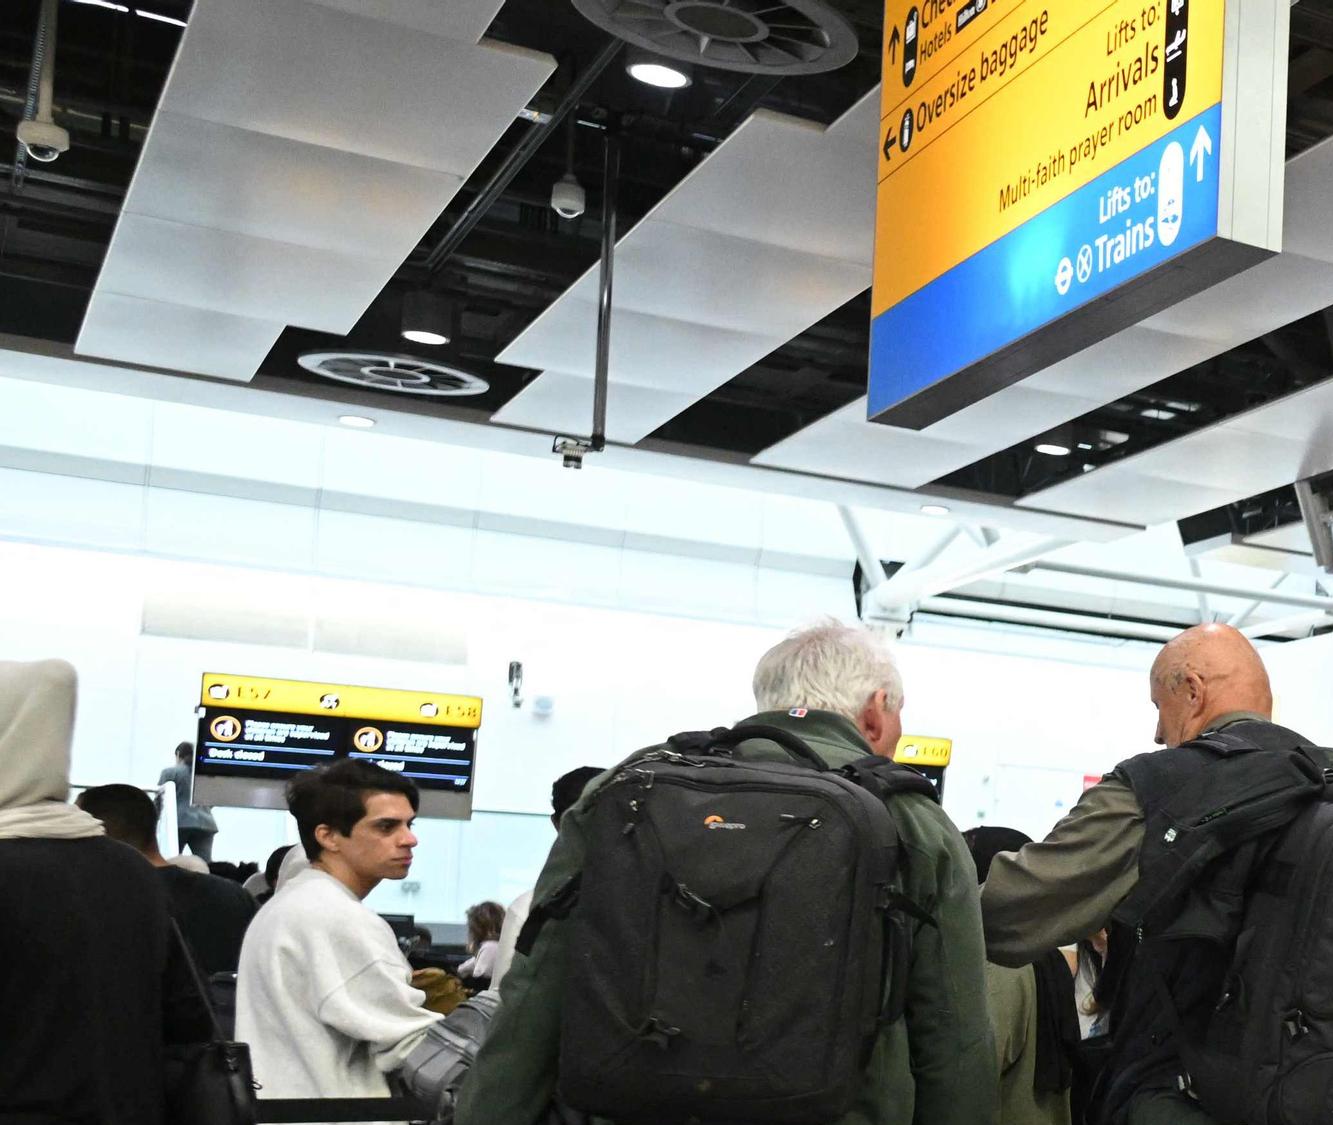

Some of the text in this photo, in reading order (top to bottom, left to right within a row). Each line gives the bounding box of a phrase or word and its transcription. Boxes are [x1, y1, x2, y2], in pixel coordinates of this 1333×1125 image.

[920, 22, 952, 65] Hotels
[1106, 2, 1161, 56] Lifts to:
[916, 10, 1049, 132] Oversize baggage
[1085, 42, 1159, 118] Arrivals
[999, 93, 1158, 213] Multi-faith prayer room
[1098, 171, 1156, 225] Lifts to:
[1094, 216, 1155, 273] Trains
